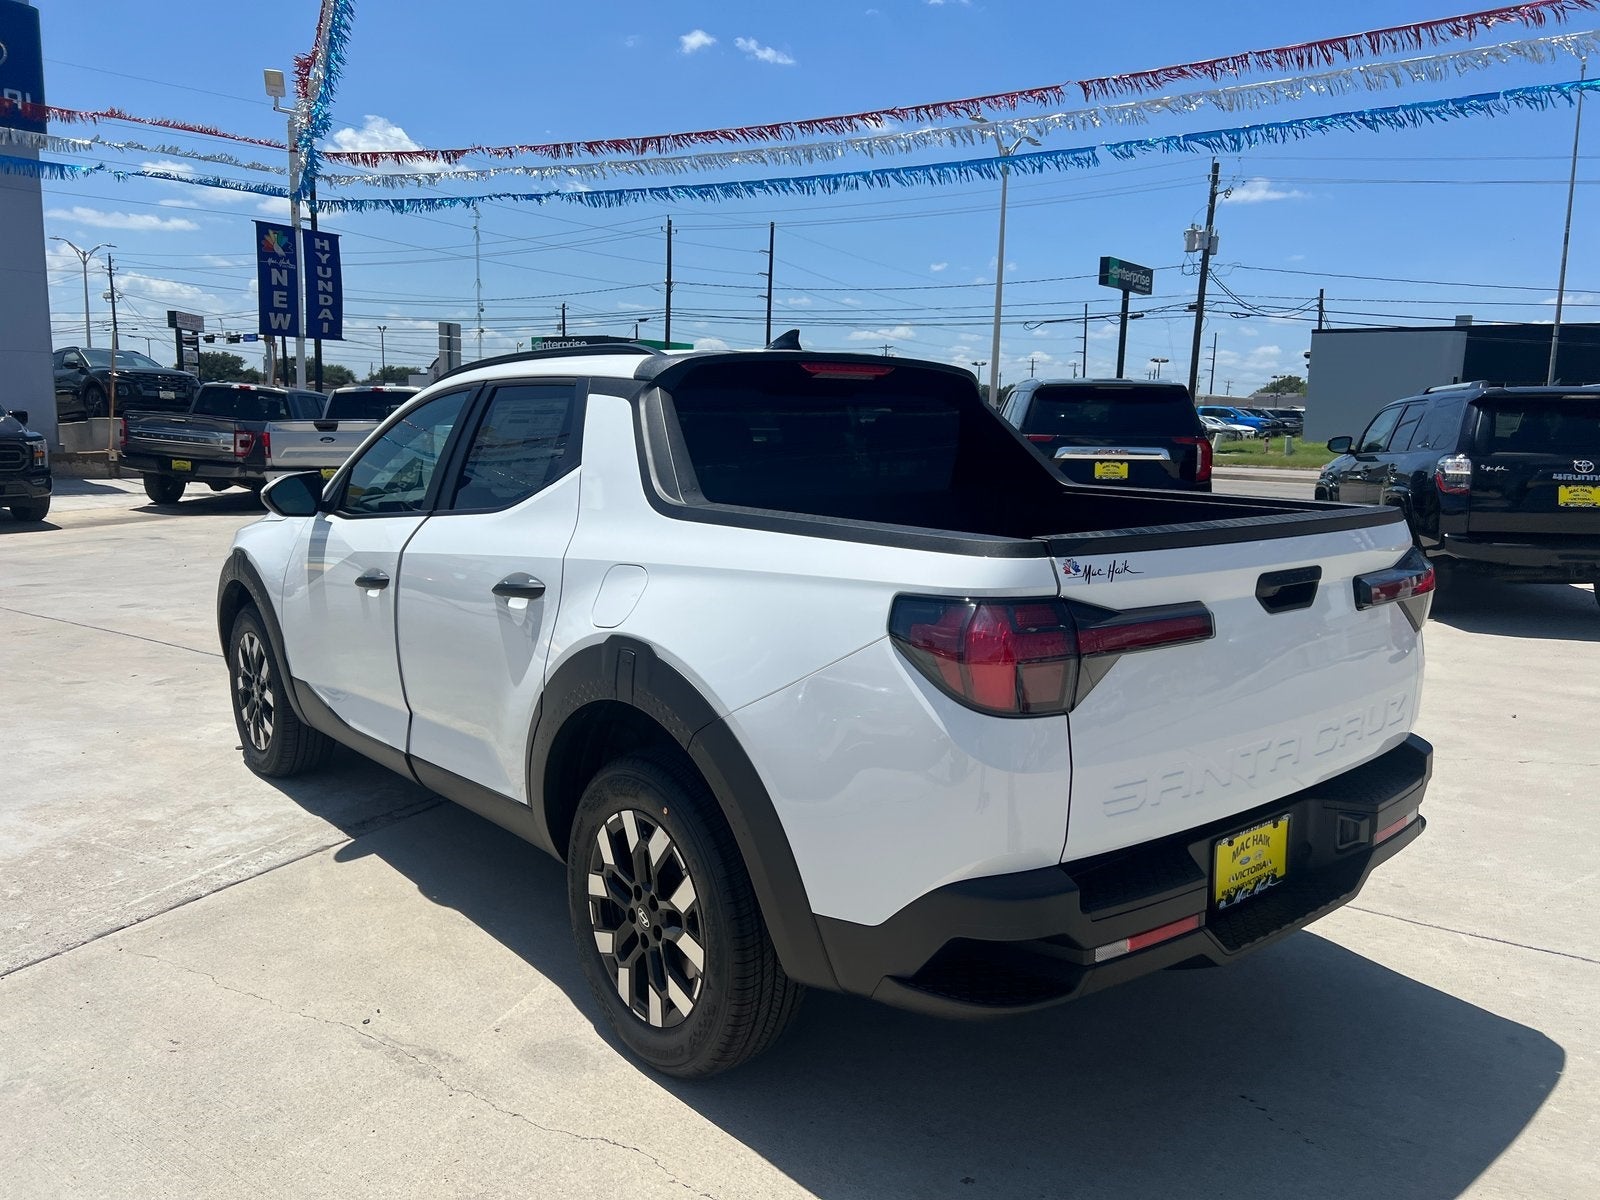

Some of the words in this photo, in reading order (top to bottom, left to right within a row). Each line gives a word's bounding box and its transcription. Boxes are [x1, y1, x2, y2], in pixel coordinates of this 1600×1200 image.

[314, 238, 334, 333] HYUNDAI
[1109, 266, 1150, 286] enterprise
[268, 268, 292, 330] NEW
[532, 339, 587, 350] enterprise
[1552, 473, 1600, 481] 4RUNN
[1082, 564, 1106, 584] Mac
[1107, 559, 1144, 582] Haik
[1103, 738, 1300, 818] SANTA
[1315, 695, 1406, 757] CRUZ
[1231, 837, 1251, 863] MAC
[1252, 833, 1271, 848] HAIK
